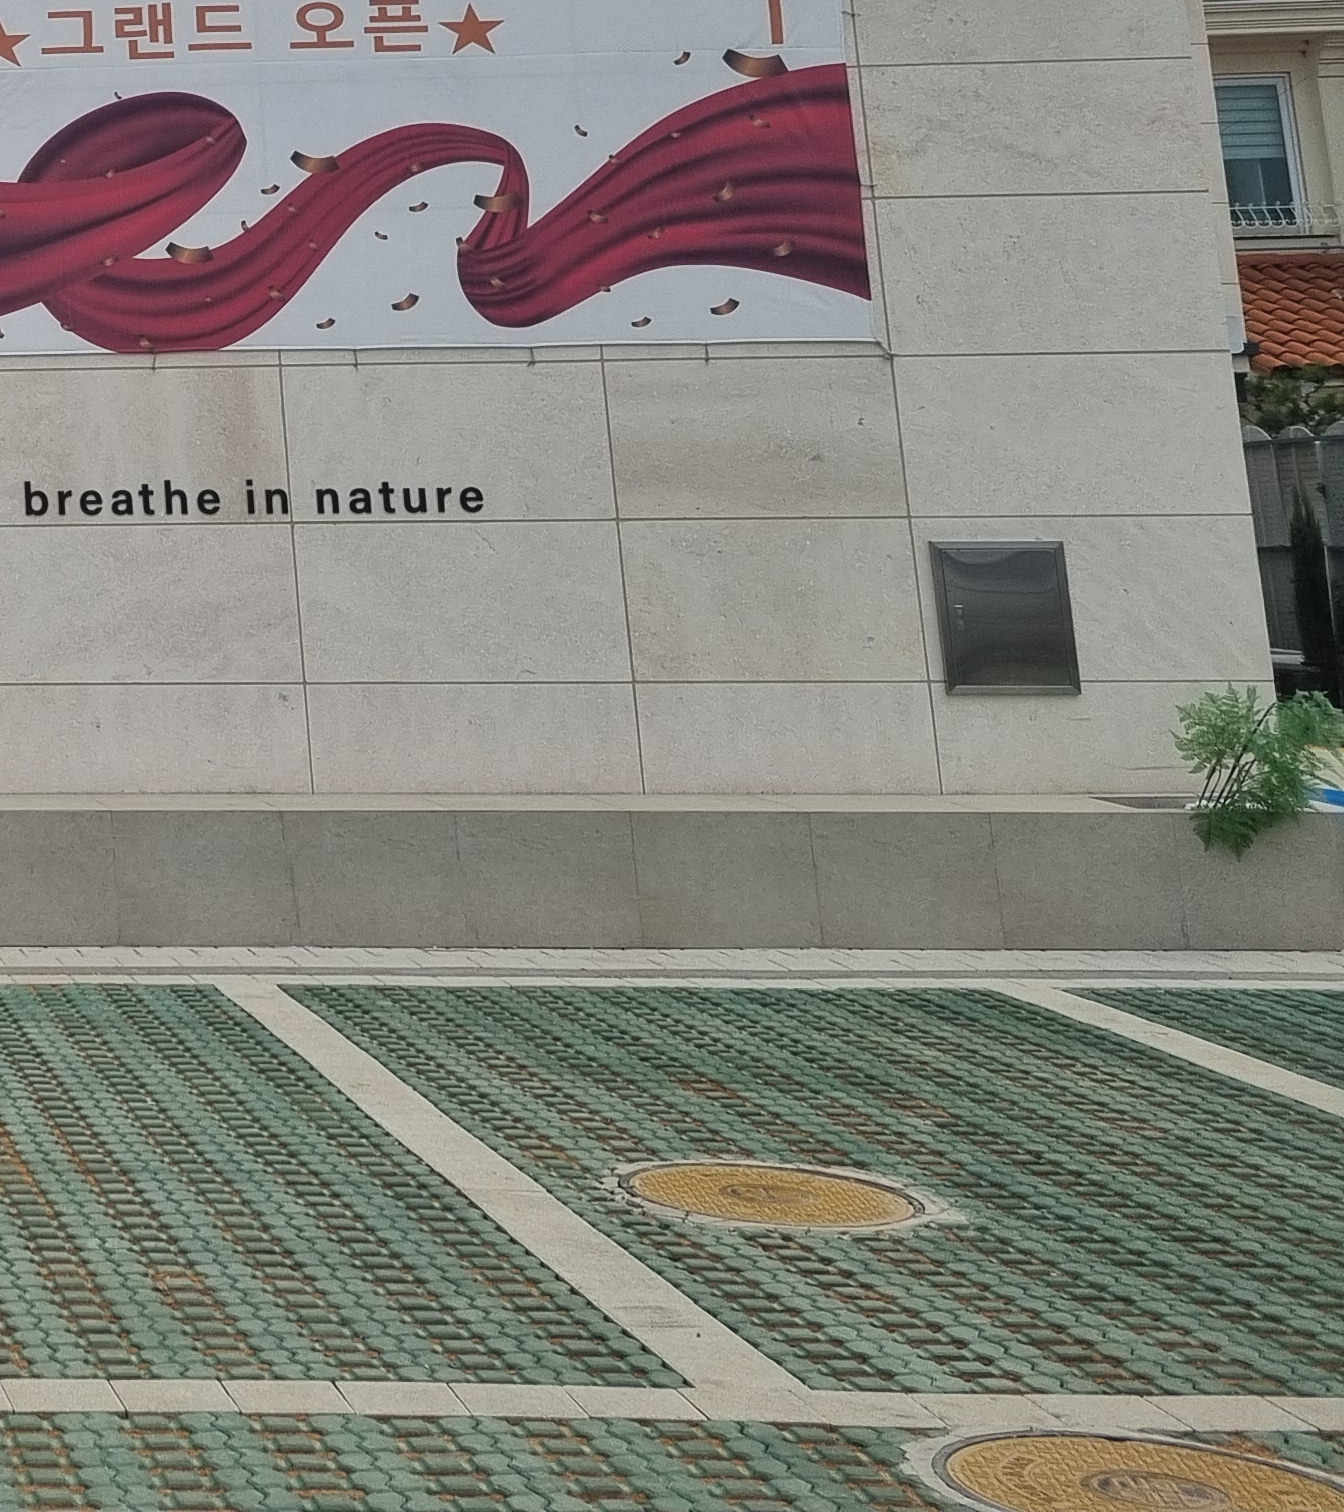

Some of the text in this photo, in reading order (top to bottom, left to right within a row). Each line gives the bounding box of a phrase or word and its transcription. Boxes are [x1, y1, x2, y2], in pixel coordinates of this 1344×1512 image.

[40, 2, 254, 62] 그랜드
[23, 479, 221, 517] breathe
[245, 479, 290, 515] in
[315, 481, 485, 515] nature
